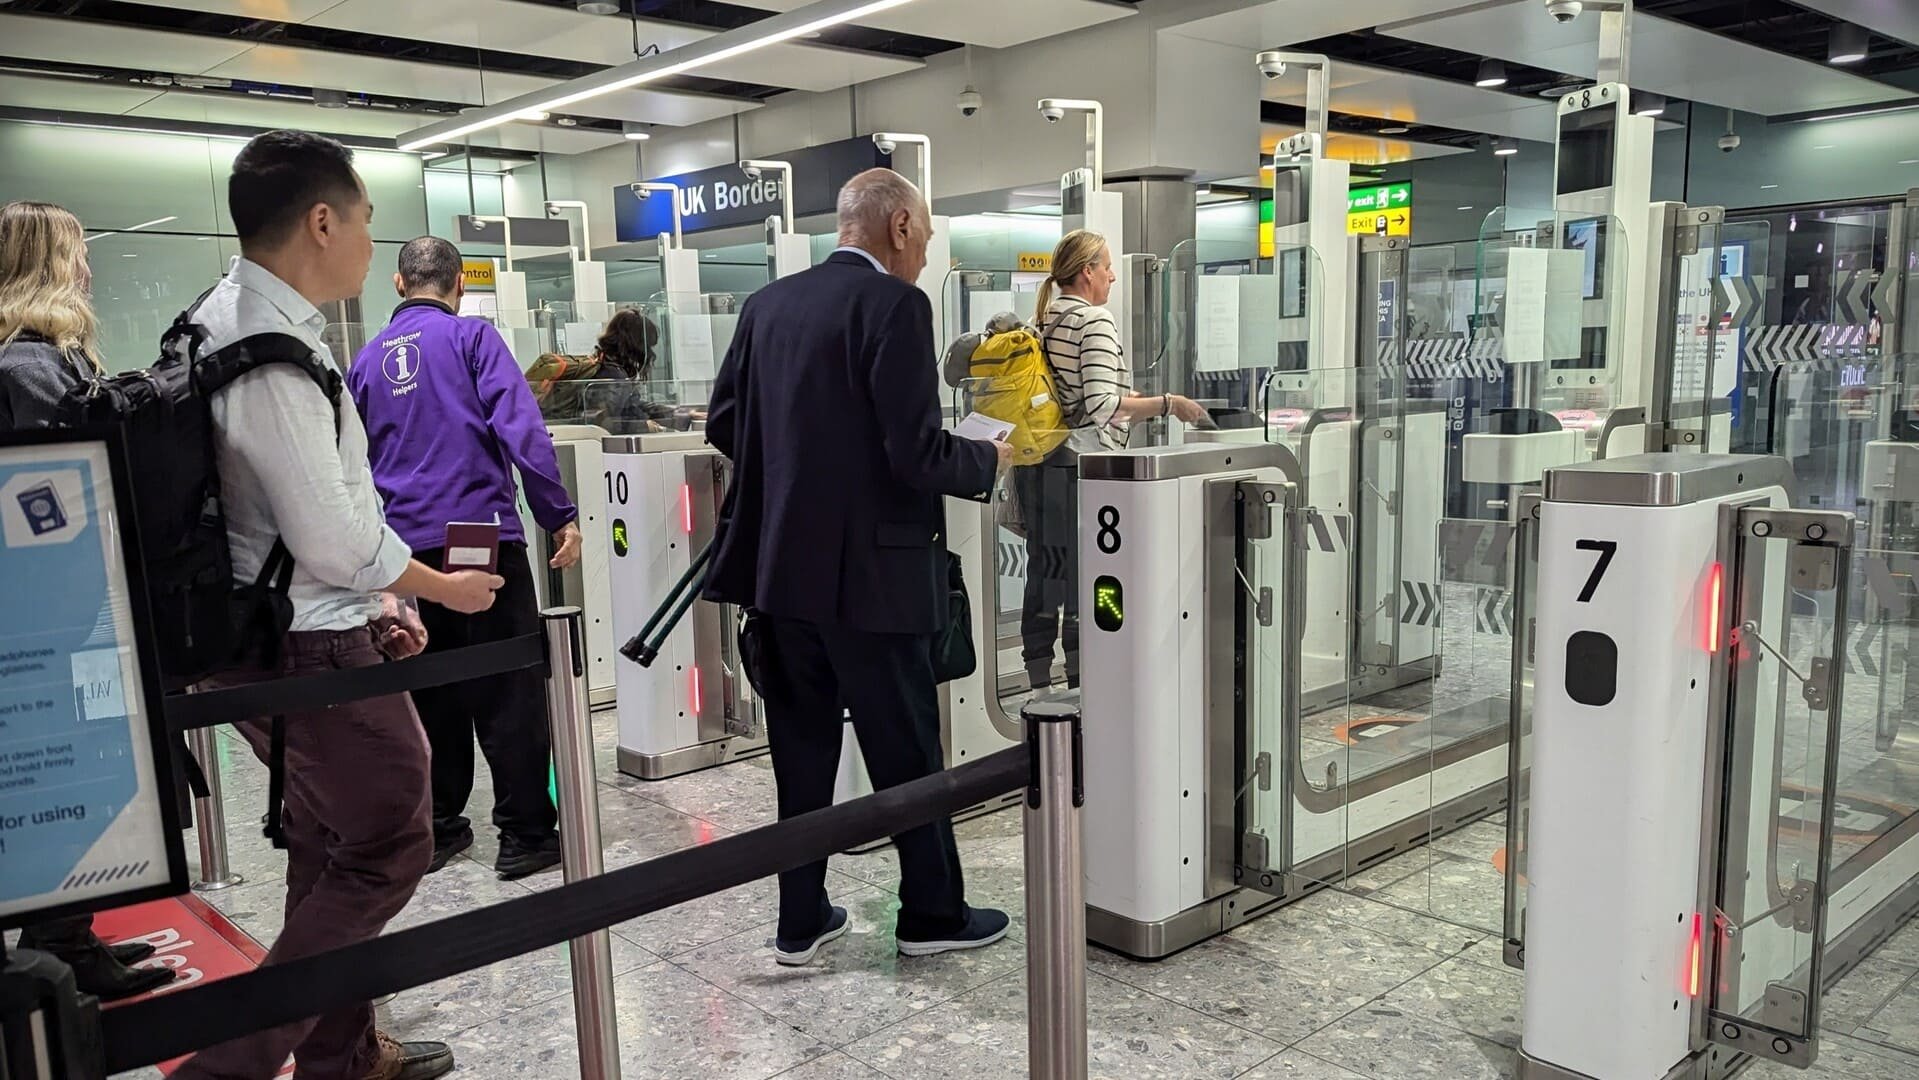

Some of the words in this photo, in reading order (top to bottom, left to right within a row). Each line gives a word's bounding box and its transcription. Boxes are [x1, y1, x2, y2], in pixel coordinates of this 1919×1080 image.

[1581, 89, 1590, 109] 8
[680, 184, 706, 216] UK
[1354, 194, 1375, 207] exit
[1351, 216, 1373, 229] Exit
[382, 330, 422, 349] Heathrow
[392, 381, 418, 397] Helpers
[604, 470, 629, 505] 10
[1096, 505, 1122, 554] 8
[1575, 539, 1617, 602] 7
[20, 701, 33, 712] to
[36, 699, 54, 711] the
[12, 749, 44, 762] down
[46, 743, 73, 755] front
[15, 761, 41, 773] hold
[44, 756, 76, 769] firmly
[31, 804, 86, 825] using
